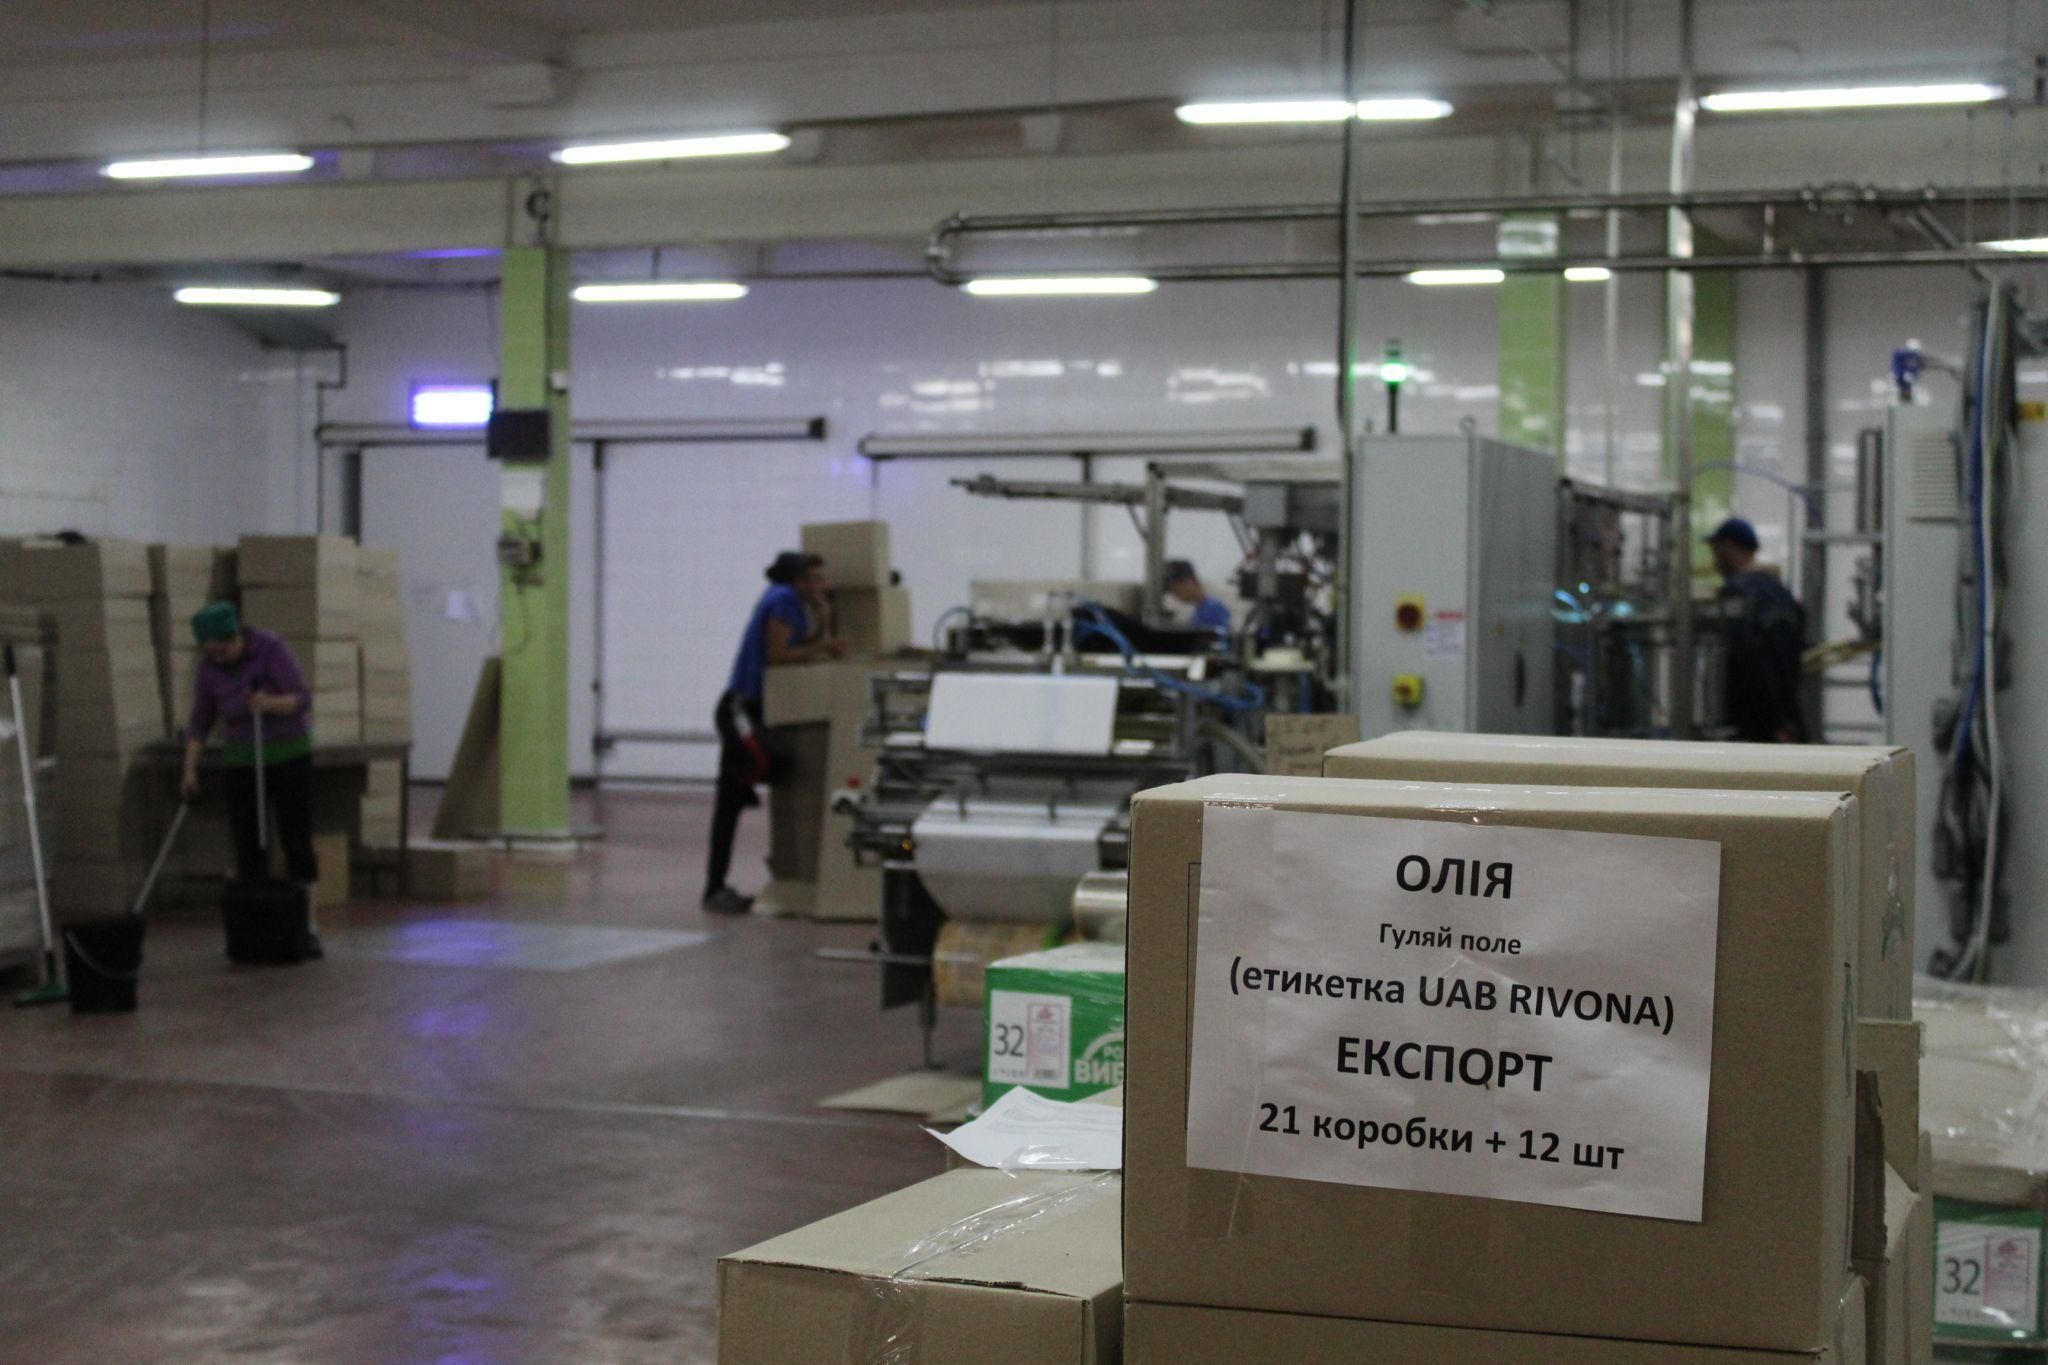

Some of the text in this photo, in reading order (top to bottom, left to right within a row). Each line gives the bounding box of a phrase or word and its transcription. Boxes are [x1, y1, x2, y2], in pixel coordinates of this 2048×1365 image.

[1396, 854, 1514, 900] ОЛІЯ
[1379, 922, 1522, 955] Гуляй поле
[1230, 955, 1674, 1036] (етикетка UAB RIVONA)
[993, 1024, 1024, 1058] 32
[1337, 1036, 1553, 1092] ЕКСПОРТ
[1259, 1102, 1625, 1170] 21 коробки + 12 шт
[1943, 1256, 1981, 1296] 32
